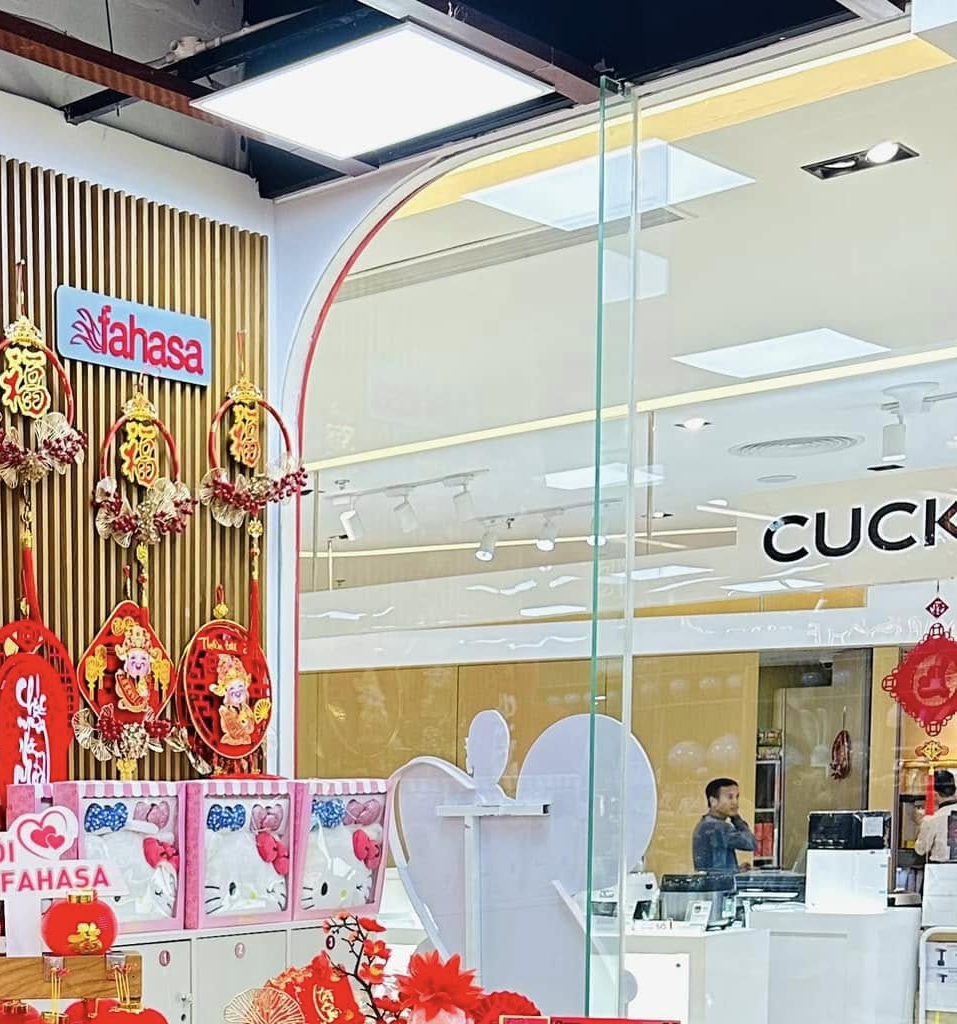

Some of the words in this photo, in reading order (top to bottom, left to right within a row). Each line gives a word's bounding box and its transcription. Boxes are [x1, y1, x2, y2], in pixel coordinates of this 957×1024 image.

[98, 305, 204, 375] fahasa
[0, 347, 51, 419] 福
[120, 420, 159, 486] 福
[229, 403, 260, 467] 福
[762, 498, 957, 563] CUCK
[1, 865, 110, 893] FAHASA
